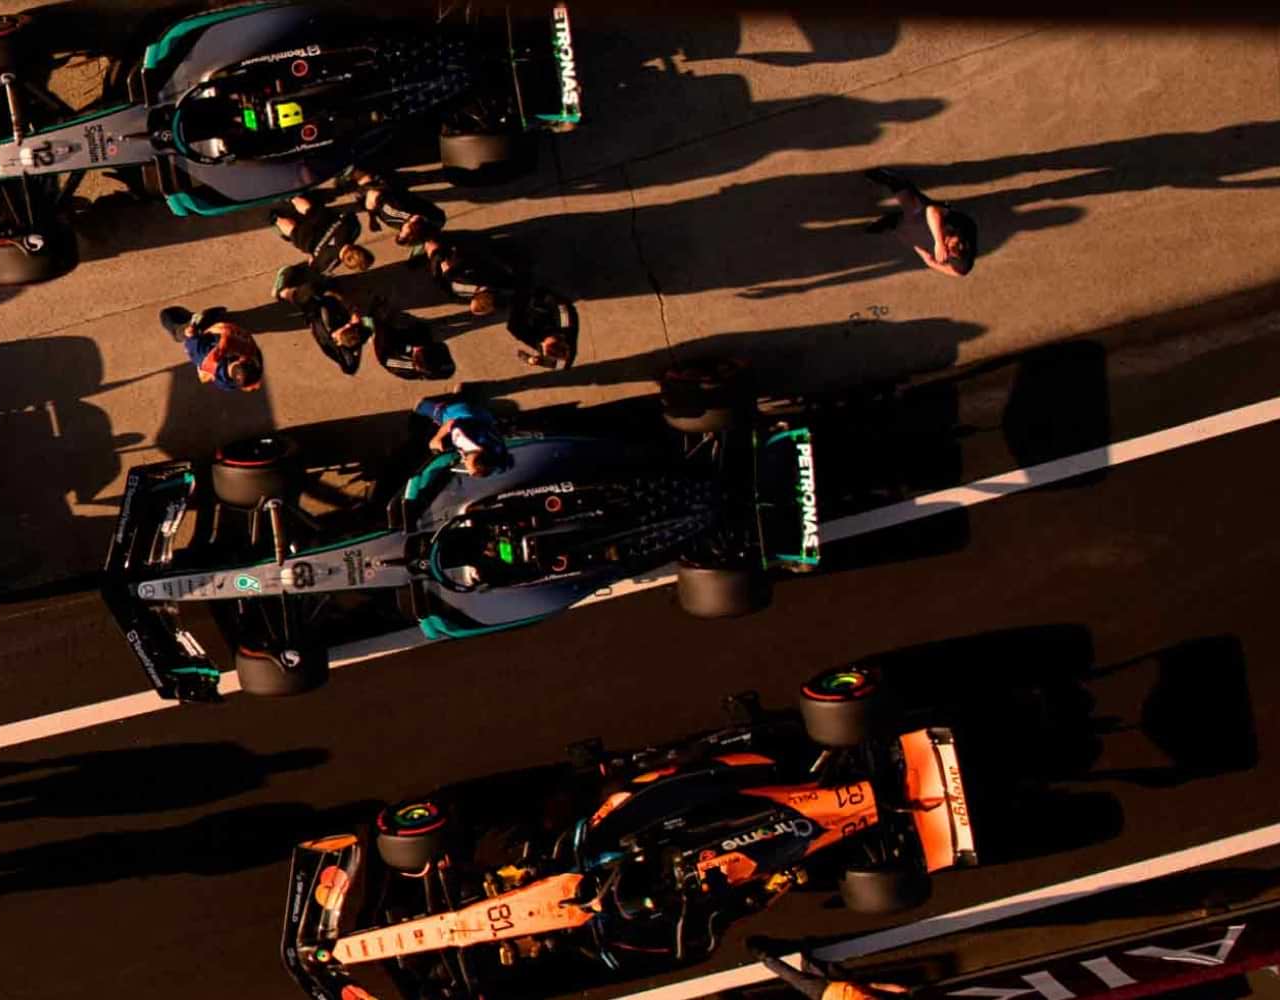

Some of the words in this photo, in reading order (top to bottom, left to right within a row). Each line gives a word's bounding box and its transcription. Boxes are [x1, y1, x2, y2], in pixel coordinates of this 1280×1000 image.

[552, 5, 580, 105] ETRONAS
[32, 140, 54, 168] 12
[796, 443, 819, 548] PETRONAS
[721, 817, 814, 851] Chrome
[487, 903, 515, 938] 81
